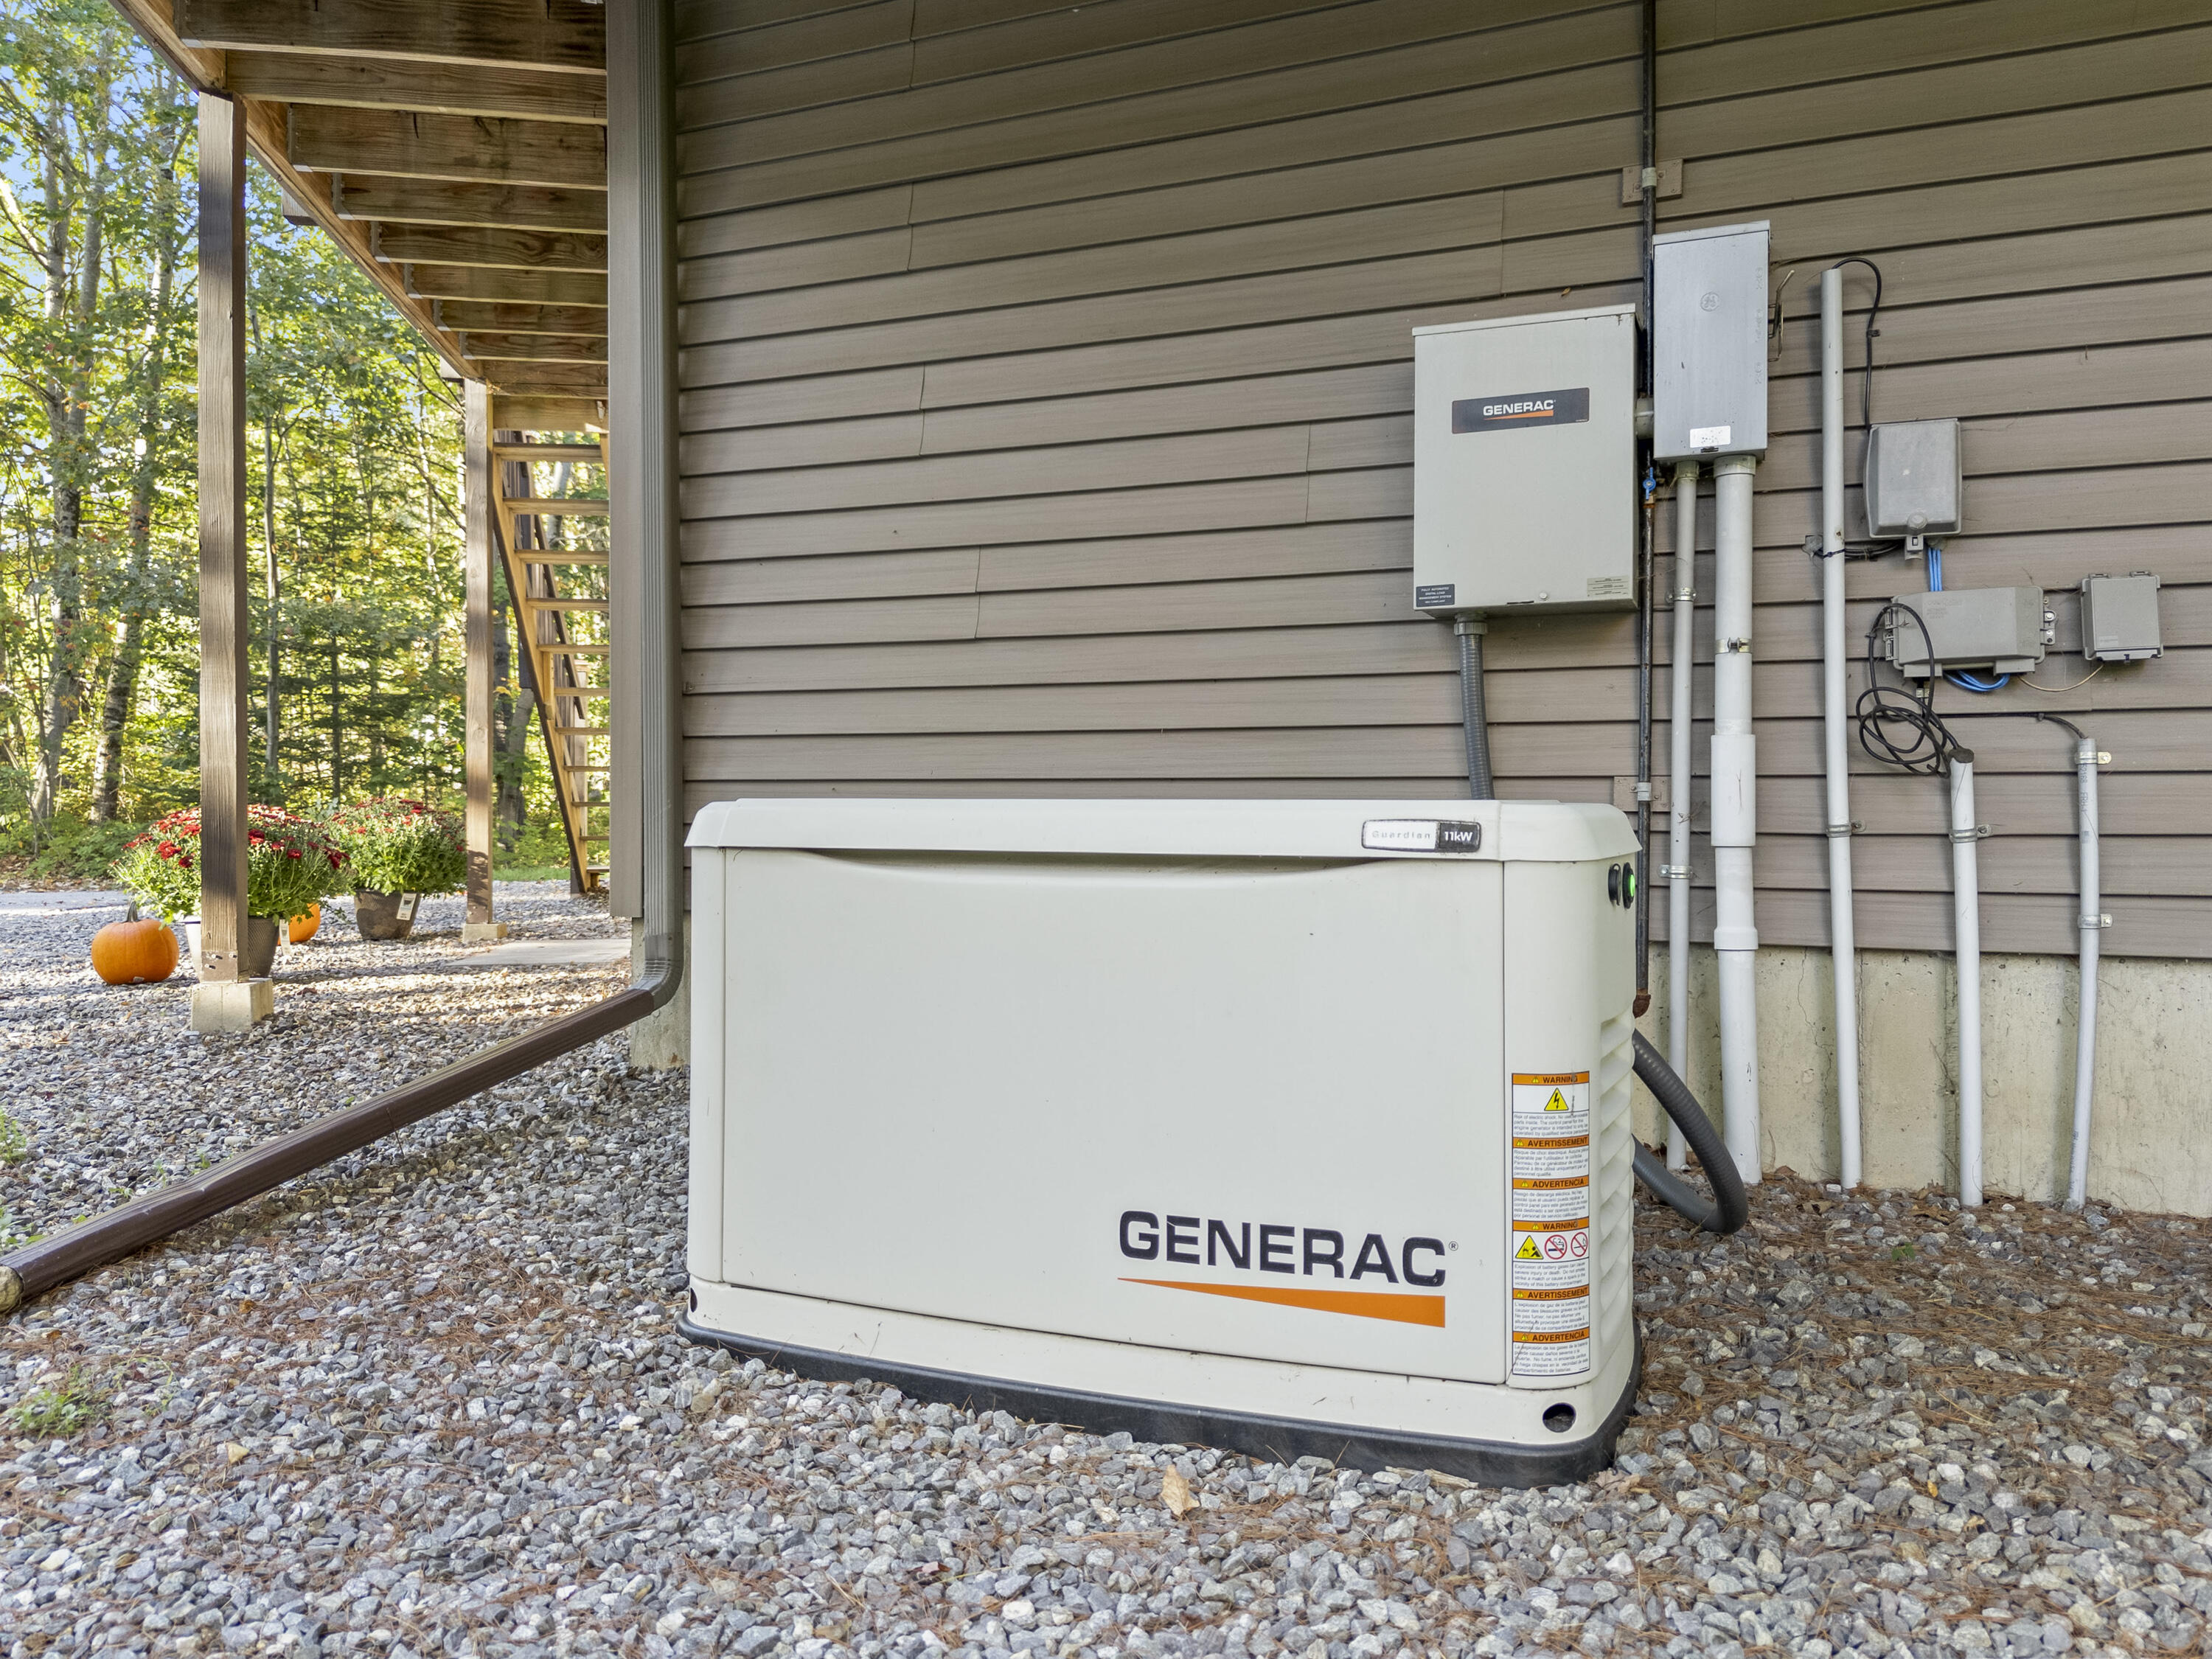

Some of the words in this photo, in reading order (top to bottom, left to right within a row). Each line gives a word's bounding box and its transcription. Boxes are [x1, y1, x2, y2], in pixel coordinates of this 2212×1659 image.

[1484, 400, 1554, 416] GENERAC
[1372, 830, 1430, 839] Guardian
[1444, 831, 1473, 841] 11kW
[1528, 1137, 1587, 1147] AVERTISSEMENT
[1532, 1178, 1584, 1187] ADVERTENCIA
[1543, 1221, 1578, 1230] WARNING
[1528, 1287, 1587, 1298] AVERTISSEMENT
[1532, 1331, 1585, 1341] ADVERTENCIA
